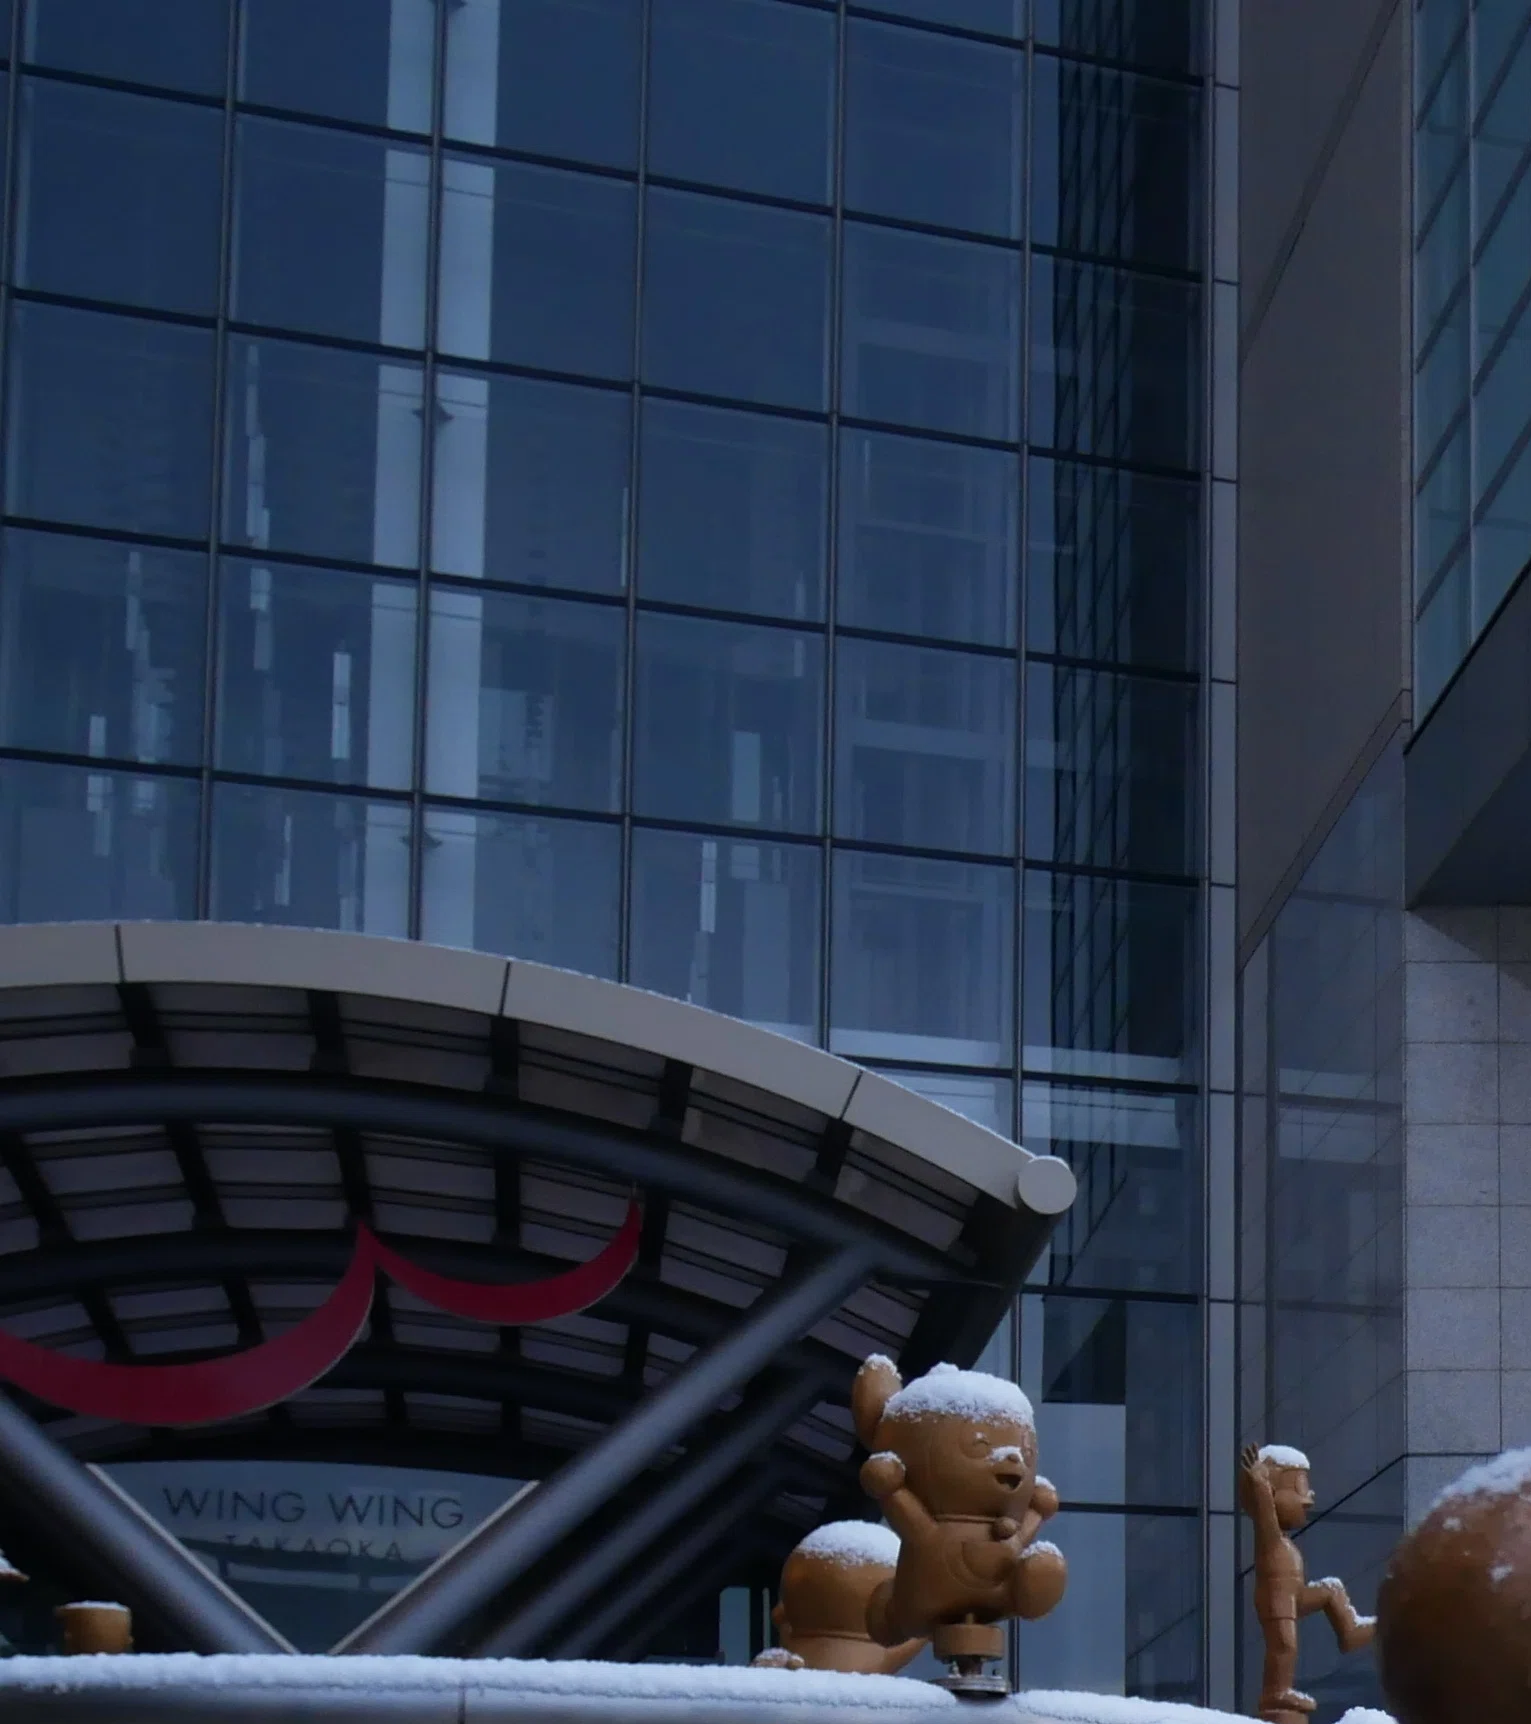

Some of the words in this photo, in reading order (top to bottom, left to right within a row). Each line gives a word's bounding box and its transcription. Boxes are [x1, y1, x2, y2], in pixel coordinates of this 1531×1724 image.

[162, 1487, 305, 1523] WING
[327, 1492, 464, 1529] WING
[225, 1534, 402, 1561] TAKAOKA
